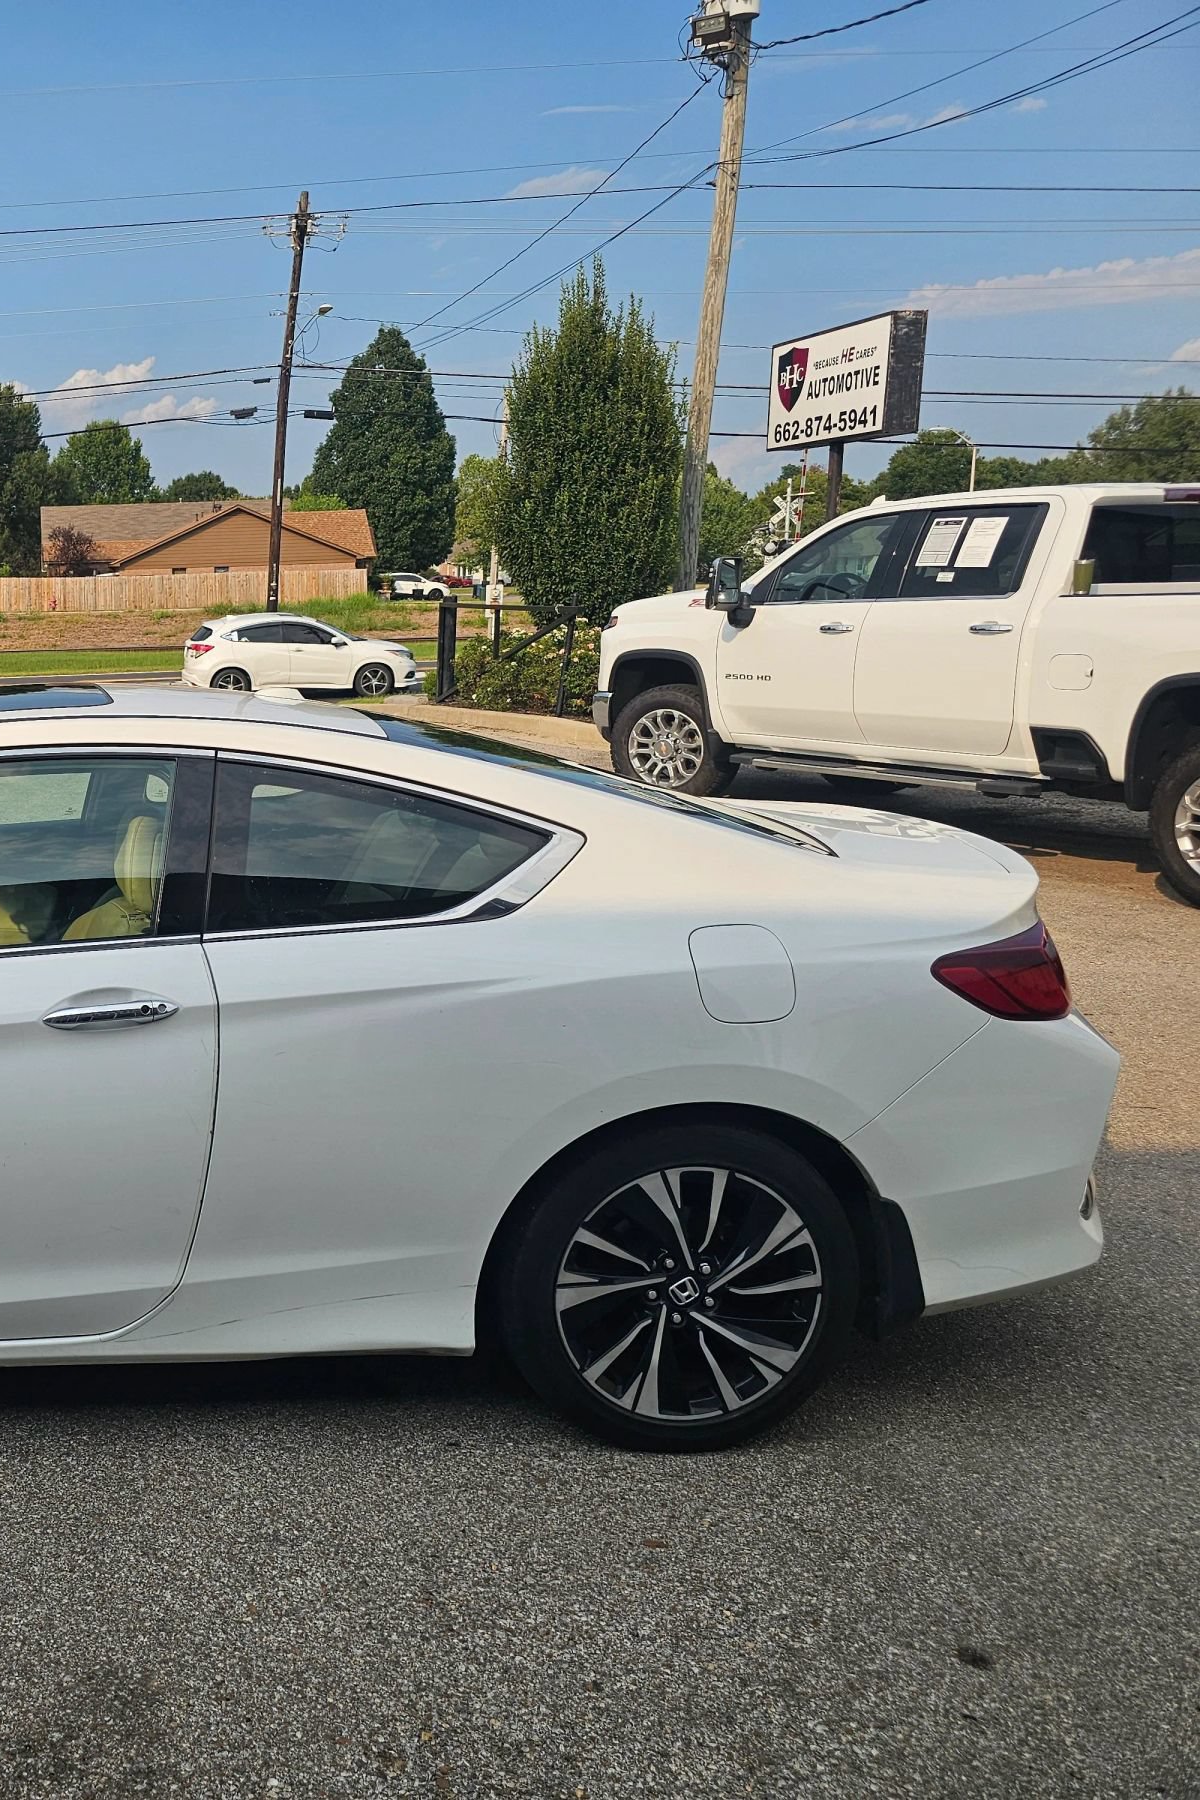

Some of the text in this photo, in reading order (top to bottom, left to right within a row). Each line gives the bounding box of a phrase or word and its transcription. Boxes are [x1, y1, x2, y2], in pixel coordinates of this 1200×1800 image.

[840, 346, 855, 364] HE
[779, 363, 804, 390] BHC
[806, 365, 881, 401] AUTOMOTIVE
[774, 404, 877, 444] 662-874-5941
[724, 673, 772, 682] 2500 HD
